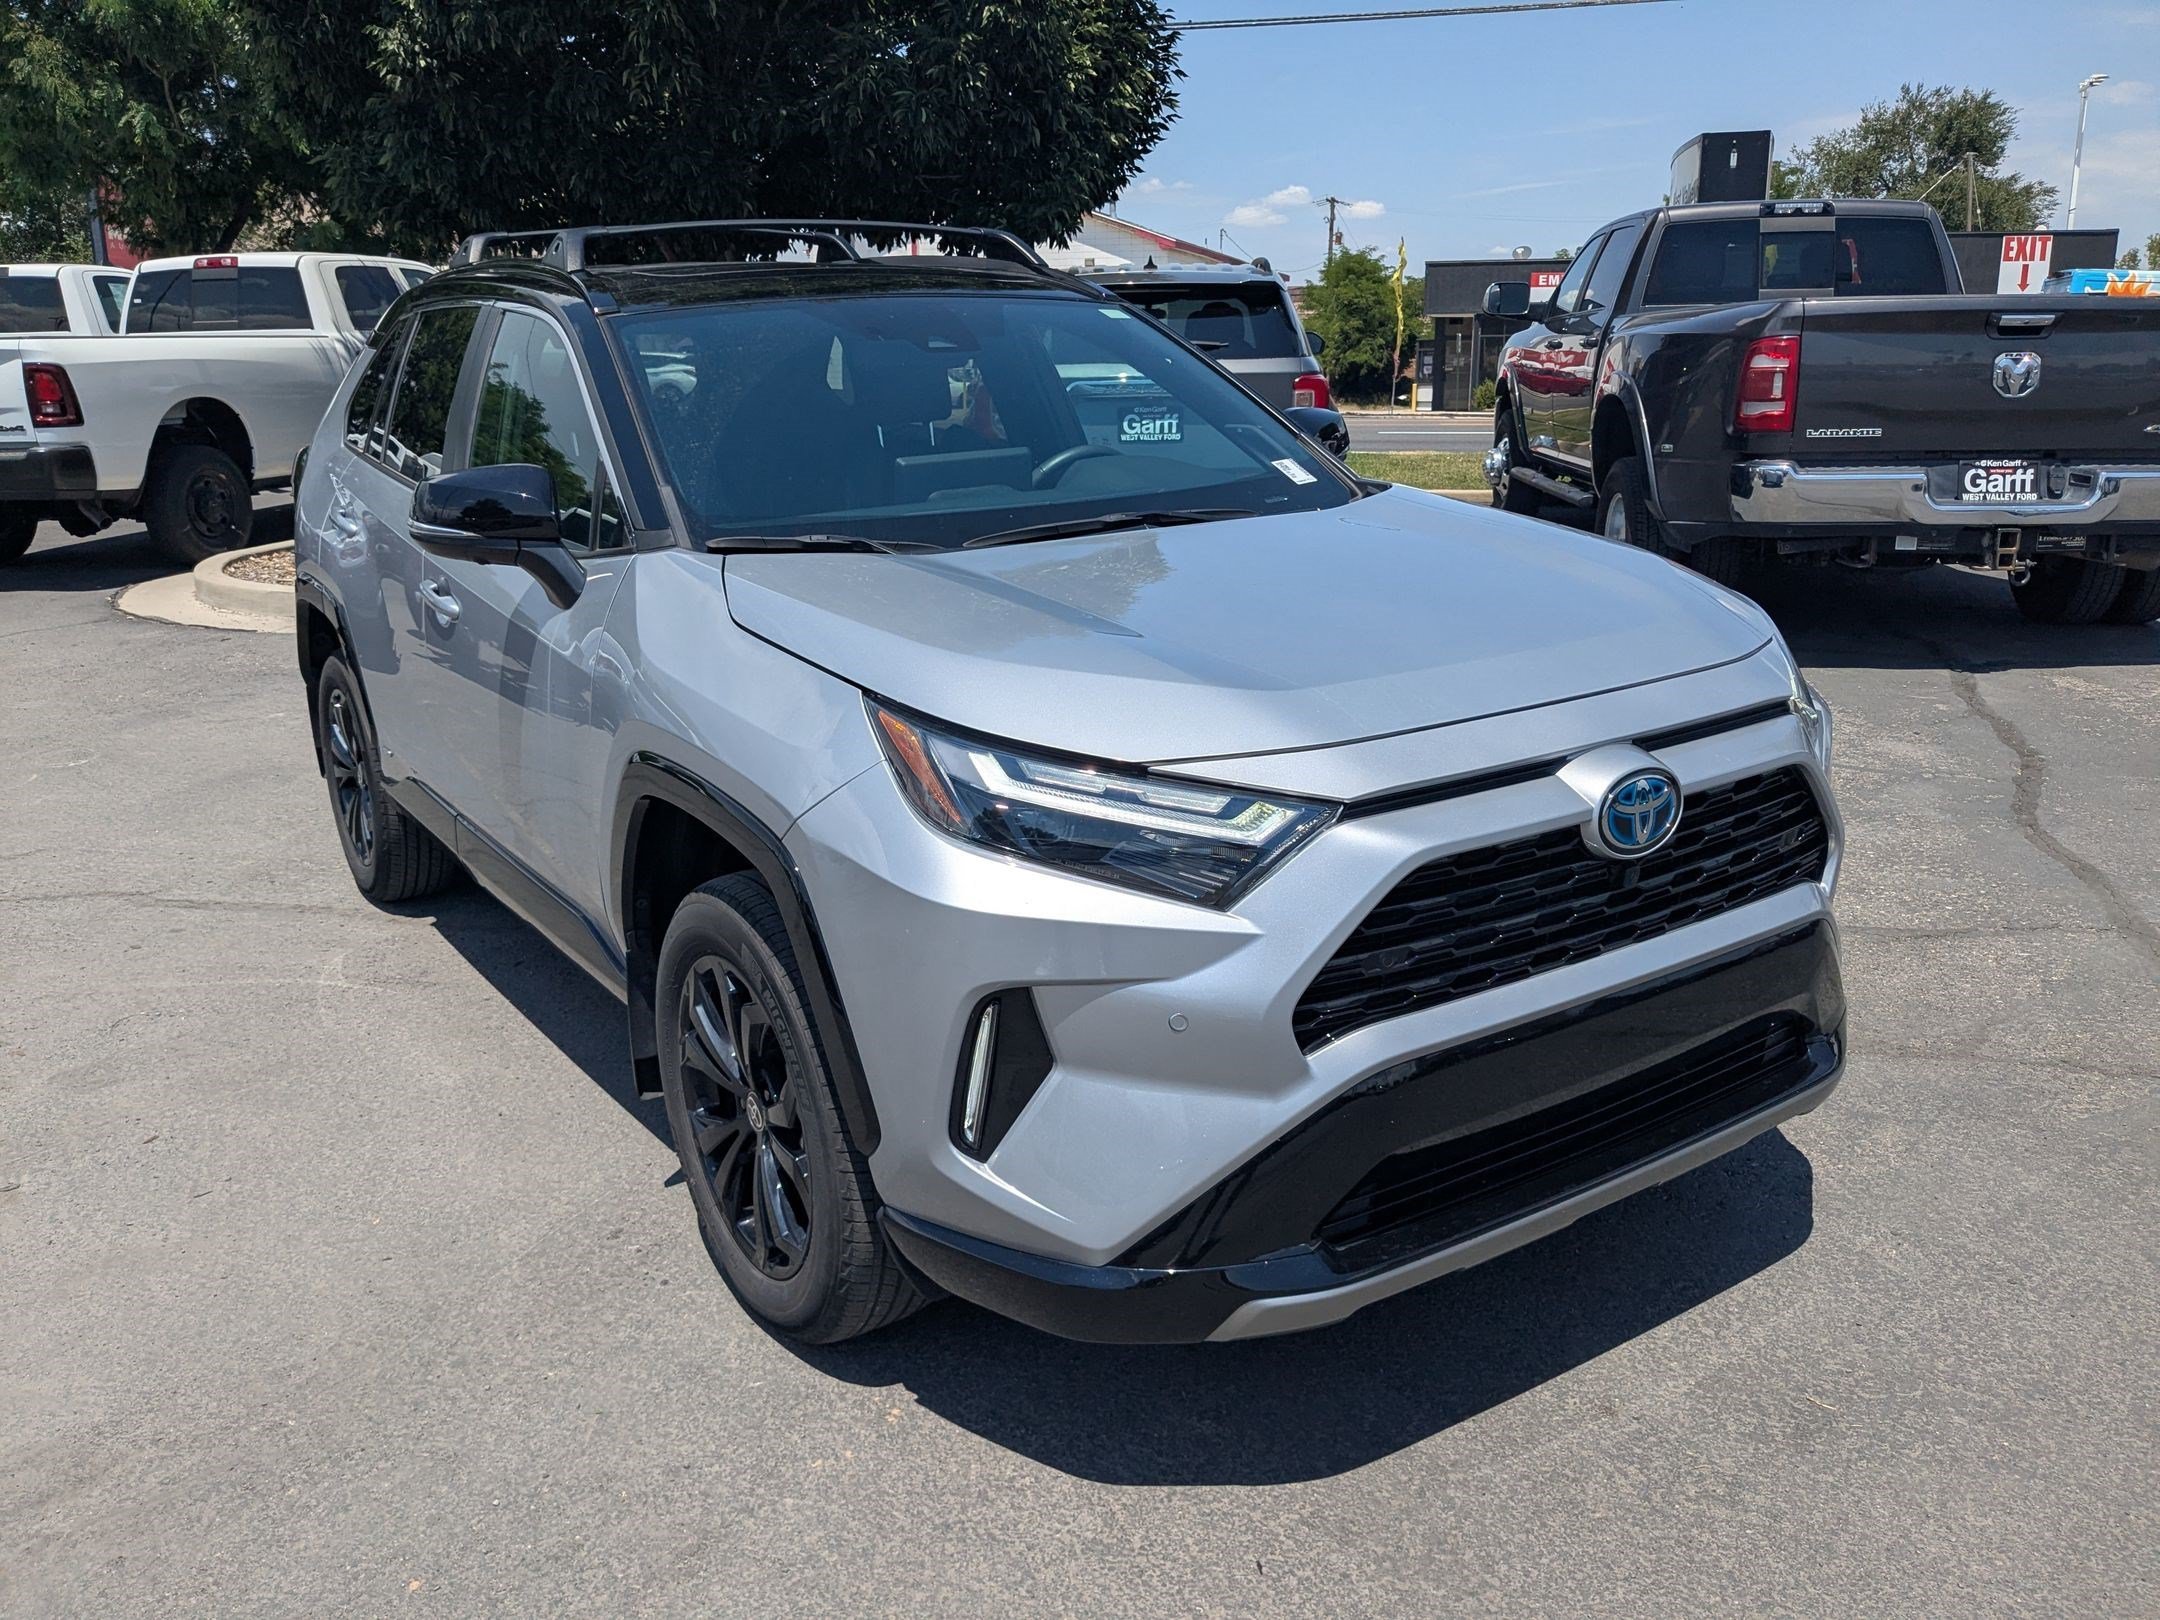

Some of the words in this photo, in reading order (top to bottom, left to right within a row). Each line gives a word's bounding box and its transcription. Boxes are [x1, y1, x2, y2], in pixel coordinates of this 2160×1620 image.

[2003, 236, 2051, 262] EXIT
[1538, 275, 1563, 286] EM
[1123, 414, 1179, 434] Garff
[1806, 428, 1882, 437] LARAMIE
[1986, 459, 2002, 467] Ken
[2002, 459, 2022, 467] Garff
[1964, 468, 2034, 493] Garff
[1962, 493, 1984, 501] WEST
[1986, 493, 2015, 501] VALLEY
[2016, 493, 2038, 501] FORD
